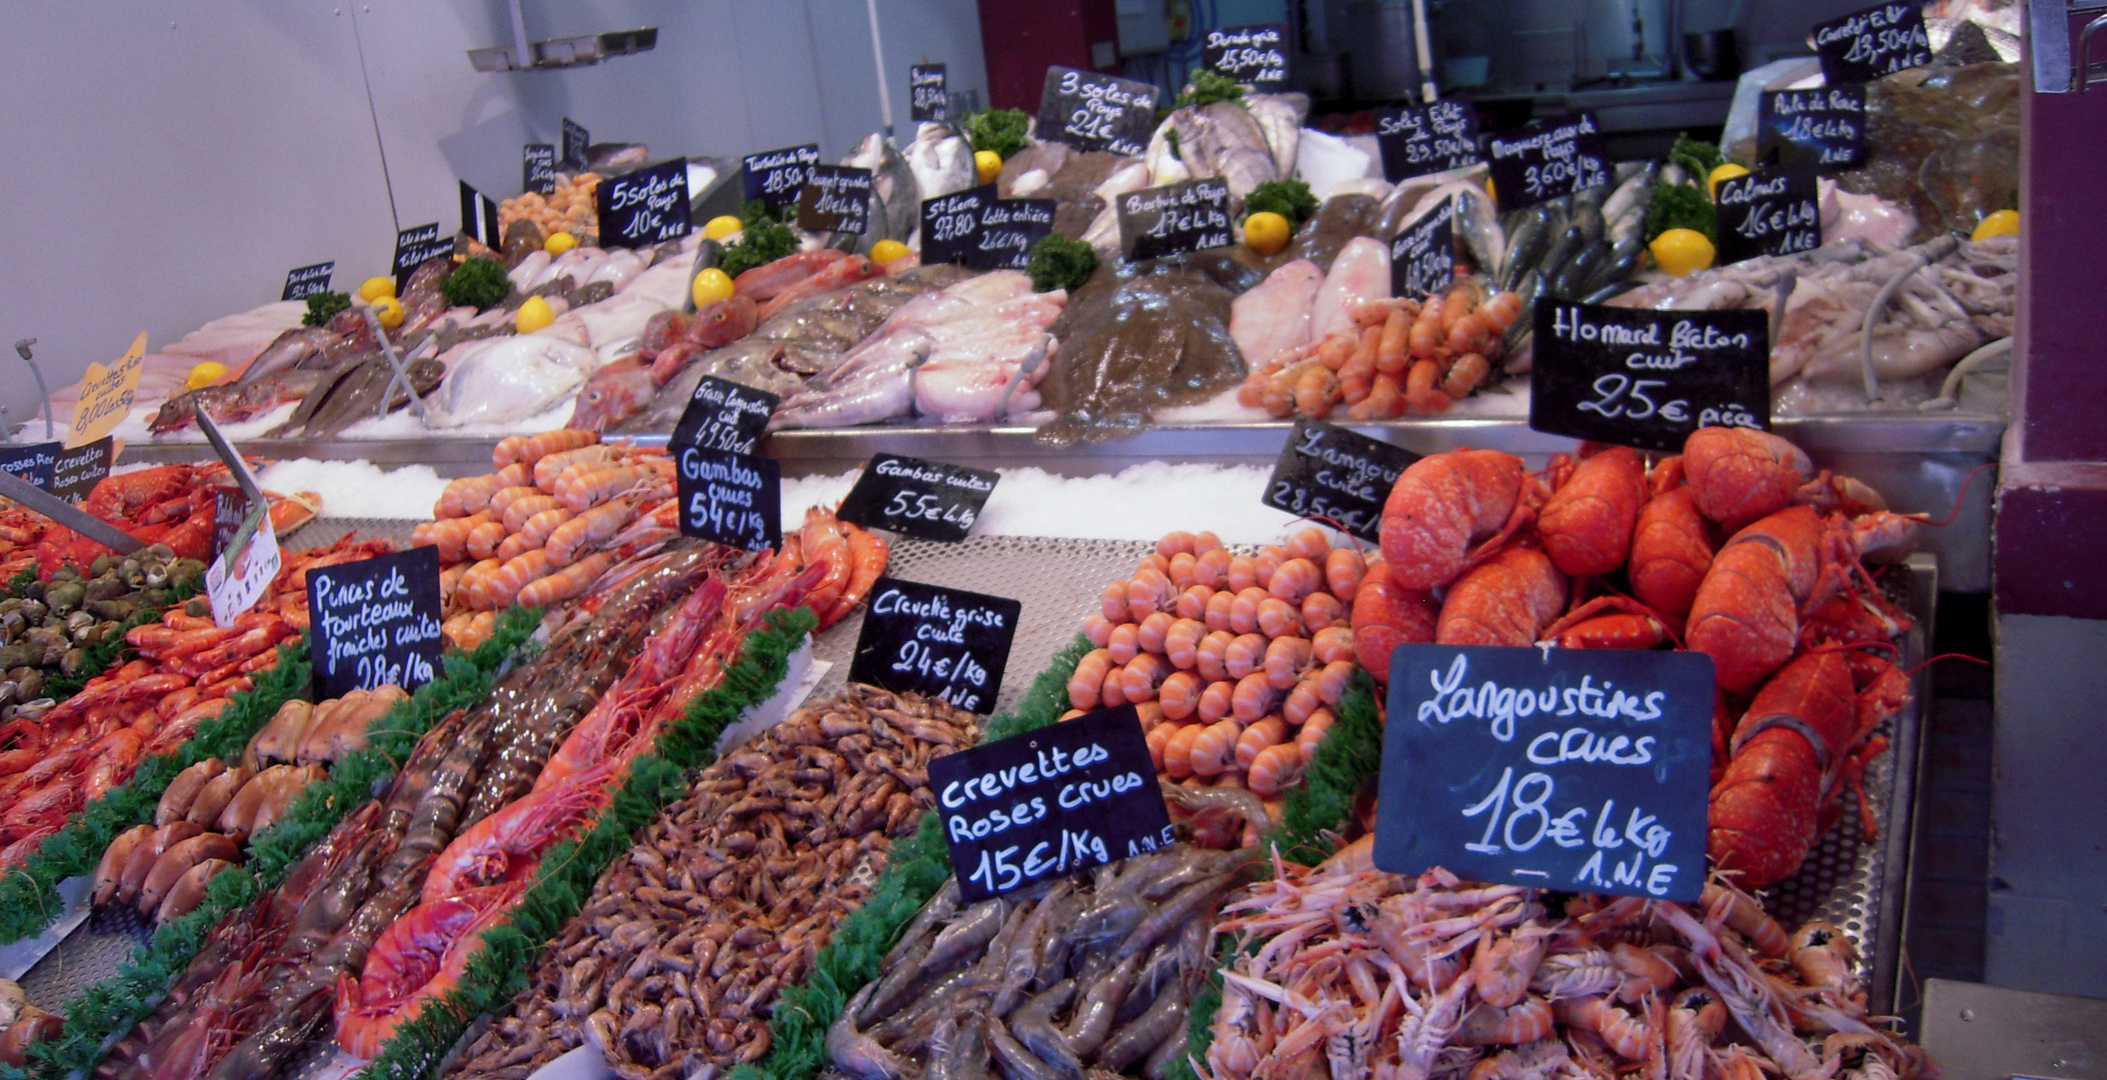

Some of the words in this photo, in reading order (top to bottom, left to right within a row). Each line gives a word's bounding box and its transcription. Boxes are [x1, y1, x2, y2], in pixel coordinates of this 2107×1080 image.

[1059, 71, 1079, 95] 3
[1133, 94, 1152, 109] de
[1809, 93, 1826, 110] de
[1064, 110, 1114, 140] 21€
[1578, 114, 1595, 134] de
[1781, 115, 1824, 141] 18€
[610, 181, 628, 210] 5
[669, 172, 686, 189] de
[1181, 188, 1198, 204] de
[622, 210, 662, 239] 10€
[933, 213, 975, 241] 27,80
[1146, 210, 1191, 237] 17€
[1735, 202, 1785, 238] 16€
[1552, 307, 1661, 345] Homard
[1668, 320, 1748, 349] Breton
[1626, 349, 1697, 369] cuit
[1577, 373, 1689, 419] 25€
[682, 447, 763, 490] Gambas
[876, 460, 943, 483] Gambas
[1295, 428, 1398, 483] Langou
[884, 490, 943, 521] 55€
[315, 573, 374, 613] Pinces
[381, 565, 409, 598] de
[321, 600, 414, 640] tourteaux
[955, 606, 1004, 631] grise
[1417, 653, 1666, 742] Langoustines
[1526, 727, 1656, 765] crues
[949, 796, 1047, 844] Roses
[1461, 766, 1588, 854] 18€
[1592, 799, 1623, 850] le
